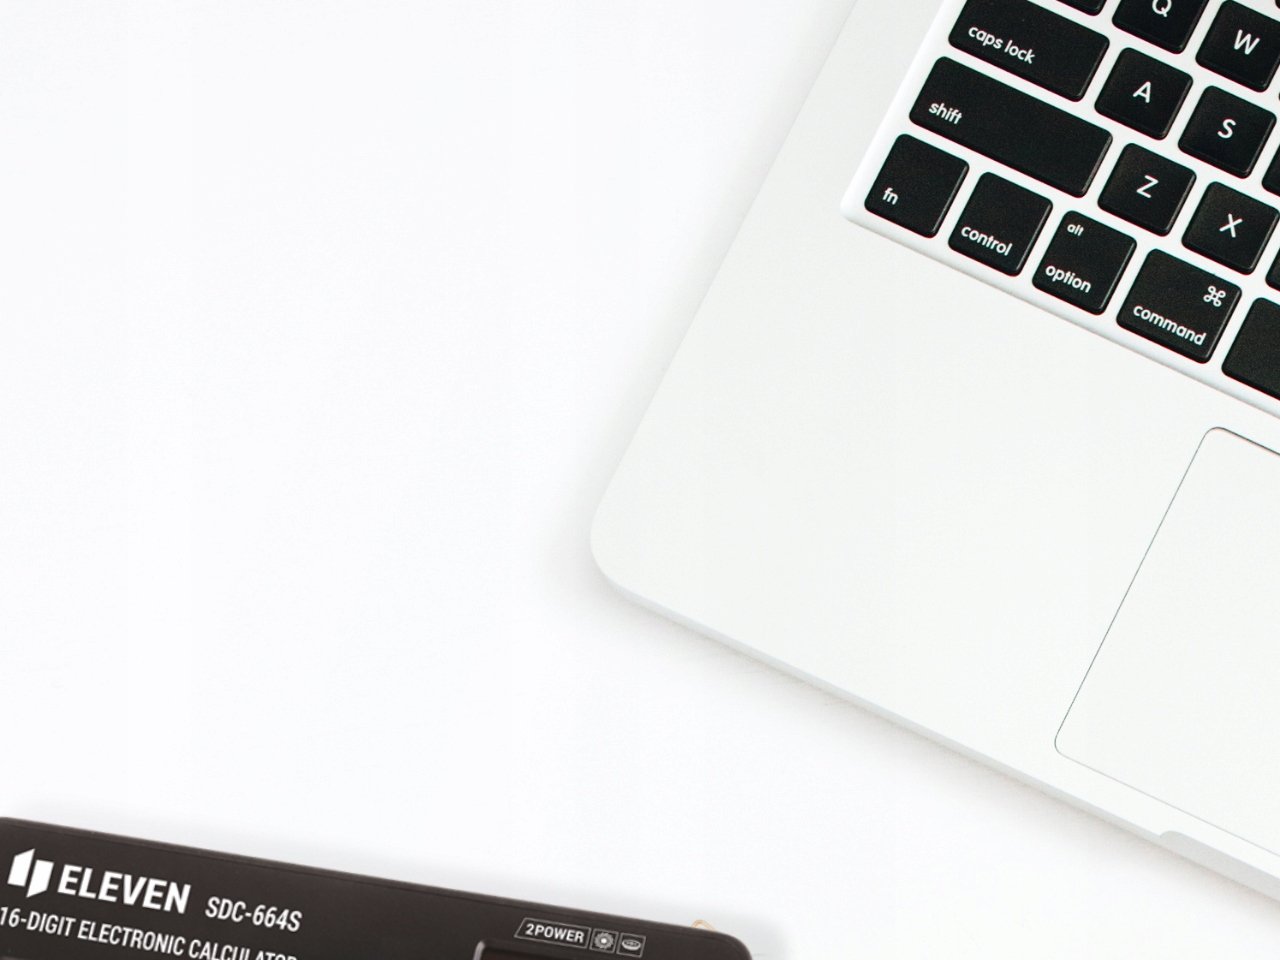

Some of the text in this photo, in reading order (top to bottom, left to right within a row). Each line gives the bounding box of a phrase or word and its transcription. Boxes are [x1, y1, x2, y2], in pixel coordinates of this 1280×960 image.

[968, 26, 1035, 64] caps lock
[1233, 29, 1260, 55] W
[1132, 81, 1152, 104] A
[928, 102, 962, 125] shift
[1217, 118, 1236, 139] S
[882, 187, 899, 205] fn
[1136, 174, 1159, 199] Z
[1067, 224, 1084, 236] alt
[1219, 213, 1243, 238] X
[960, 223, 1013, 258] control
[1045, 262, 1093, 295] option
[1132, 302, 1208, 348] command
[57, 864, 302, 932] ELEVEN SDC-664S
[0, 906, 76, 937] 16-DIGIT
[77, 919, 187, 957] ELECTRONIC
[524, 922, 584, 944] 2POWER
